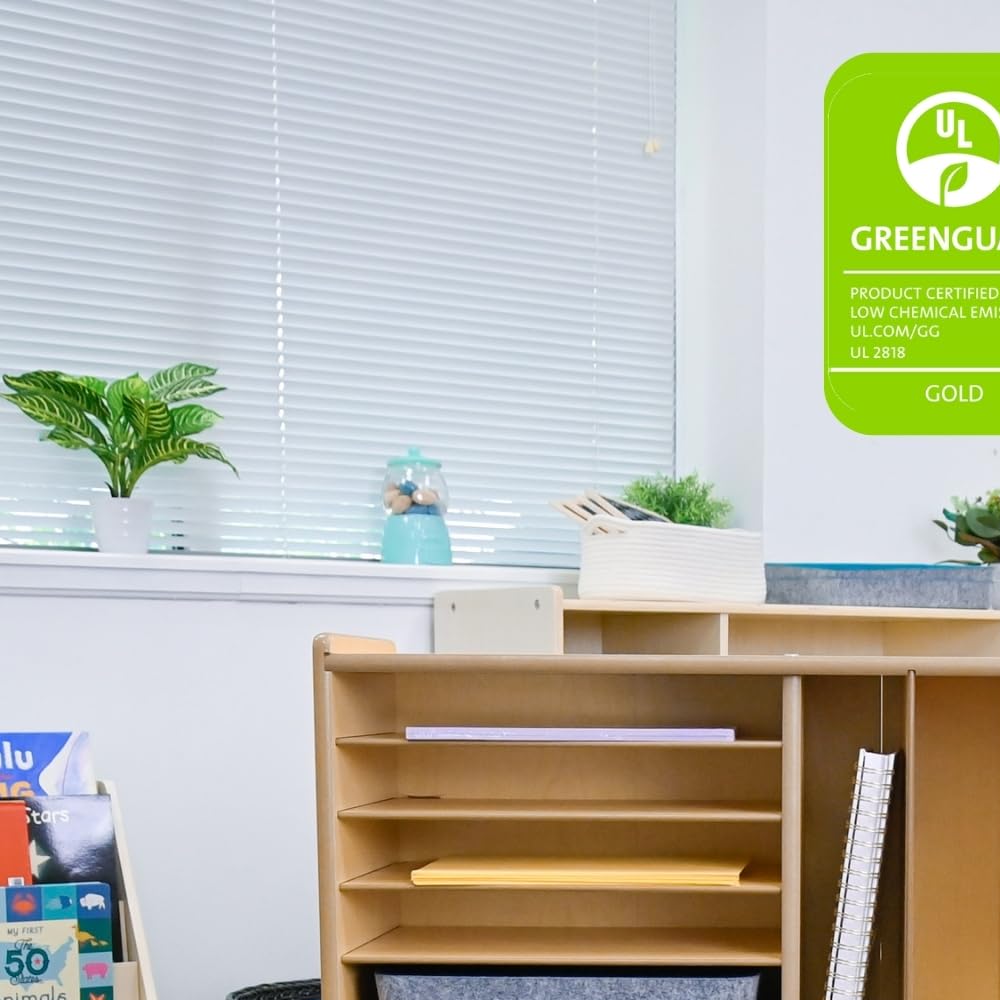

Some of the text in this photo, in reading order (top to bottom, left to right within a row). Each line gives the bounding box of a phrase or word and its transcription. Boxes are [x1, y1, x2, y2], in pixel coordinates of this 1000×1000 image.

[0, 741, 34, 770] lu
[22, 926, 44, 934] FIRST
[4, 948, 50, 977] 50
